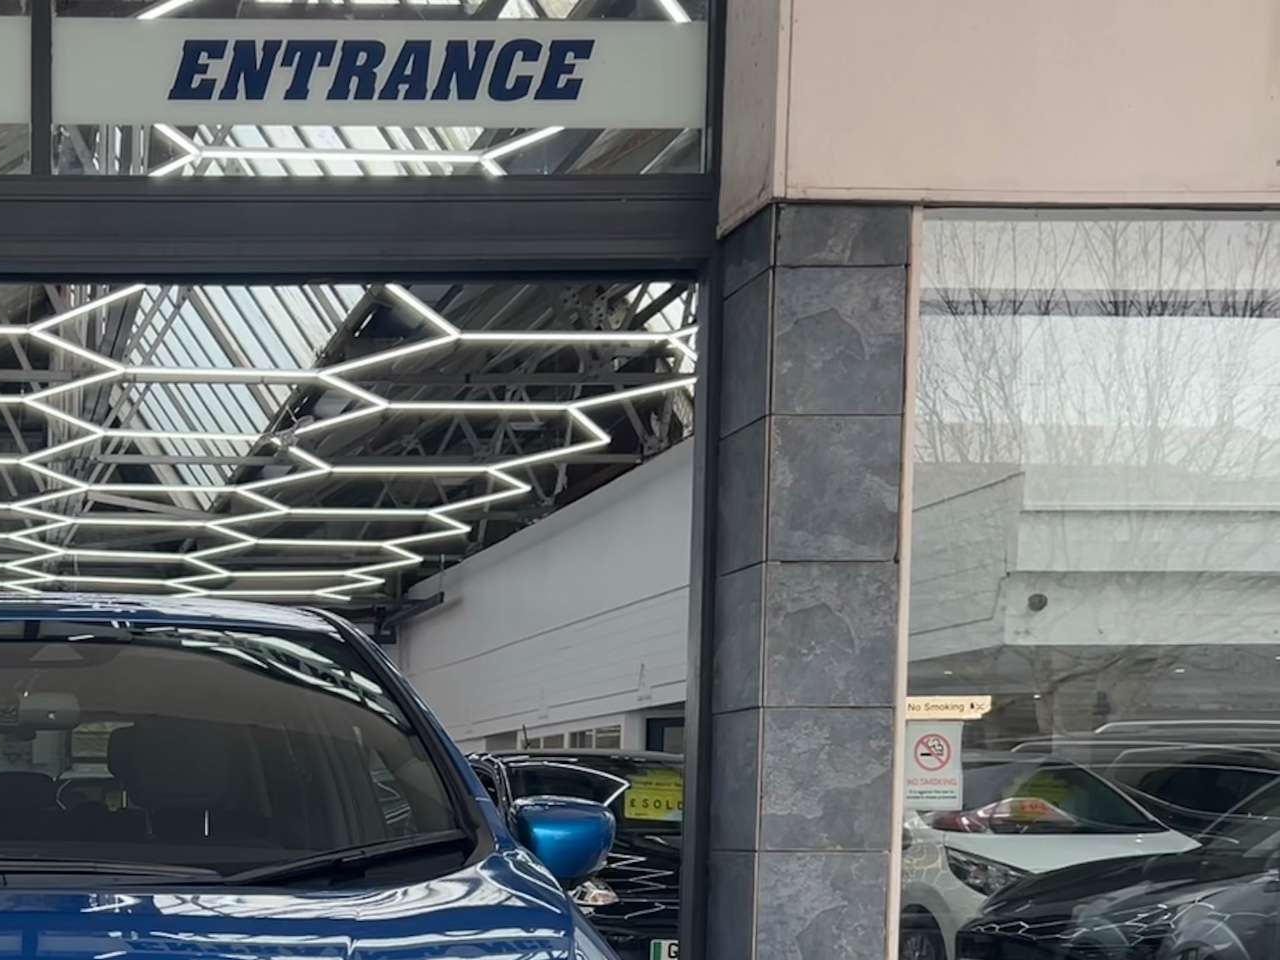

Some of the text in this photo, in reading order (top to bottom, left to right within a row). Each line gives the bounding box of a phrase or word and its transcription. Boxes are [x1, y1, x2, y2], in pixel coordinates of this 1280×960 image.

[167, 38, 596, 102] ENTRANCE
[907, 702, 965, 713] No Smoking
